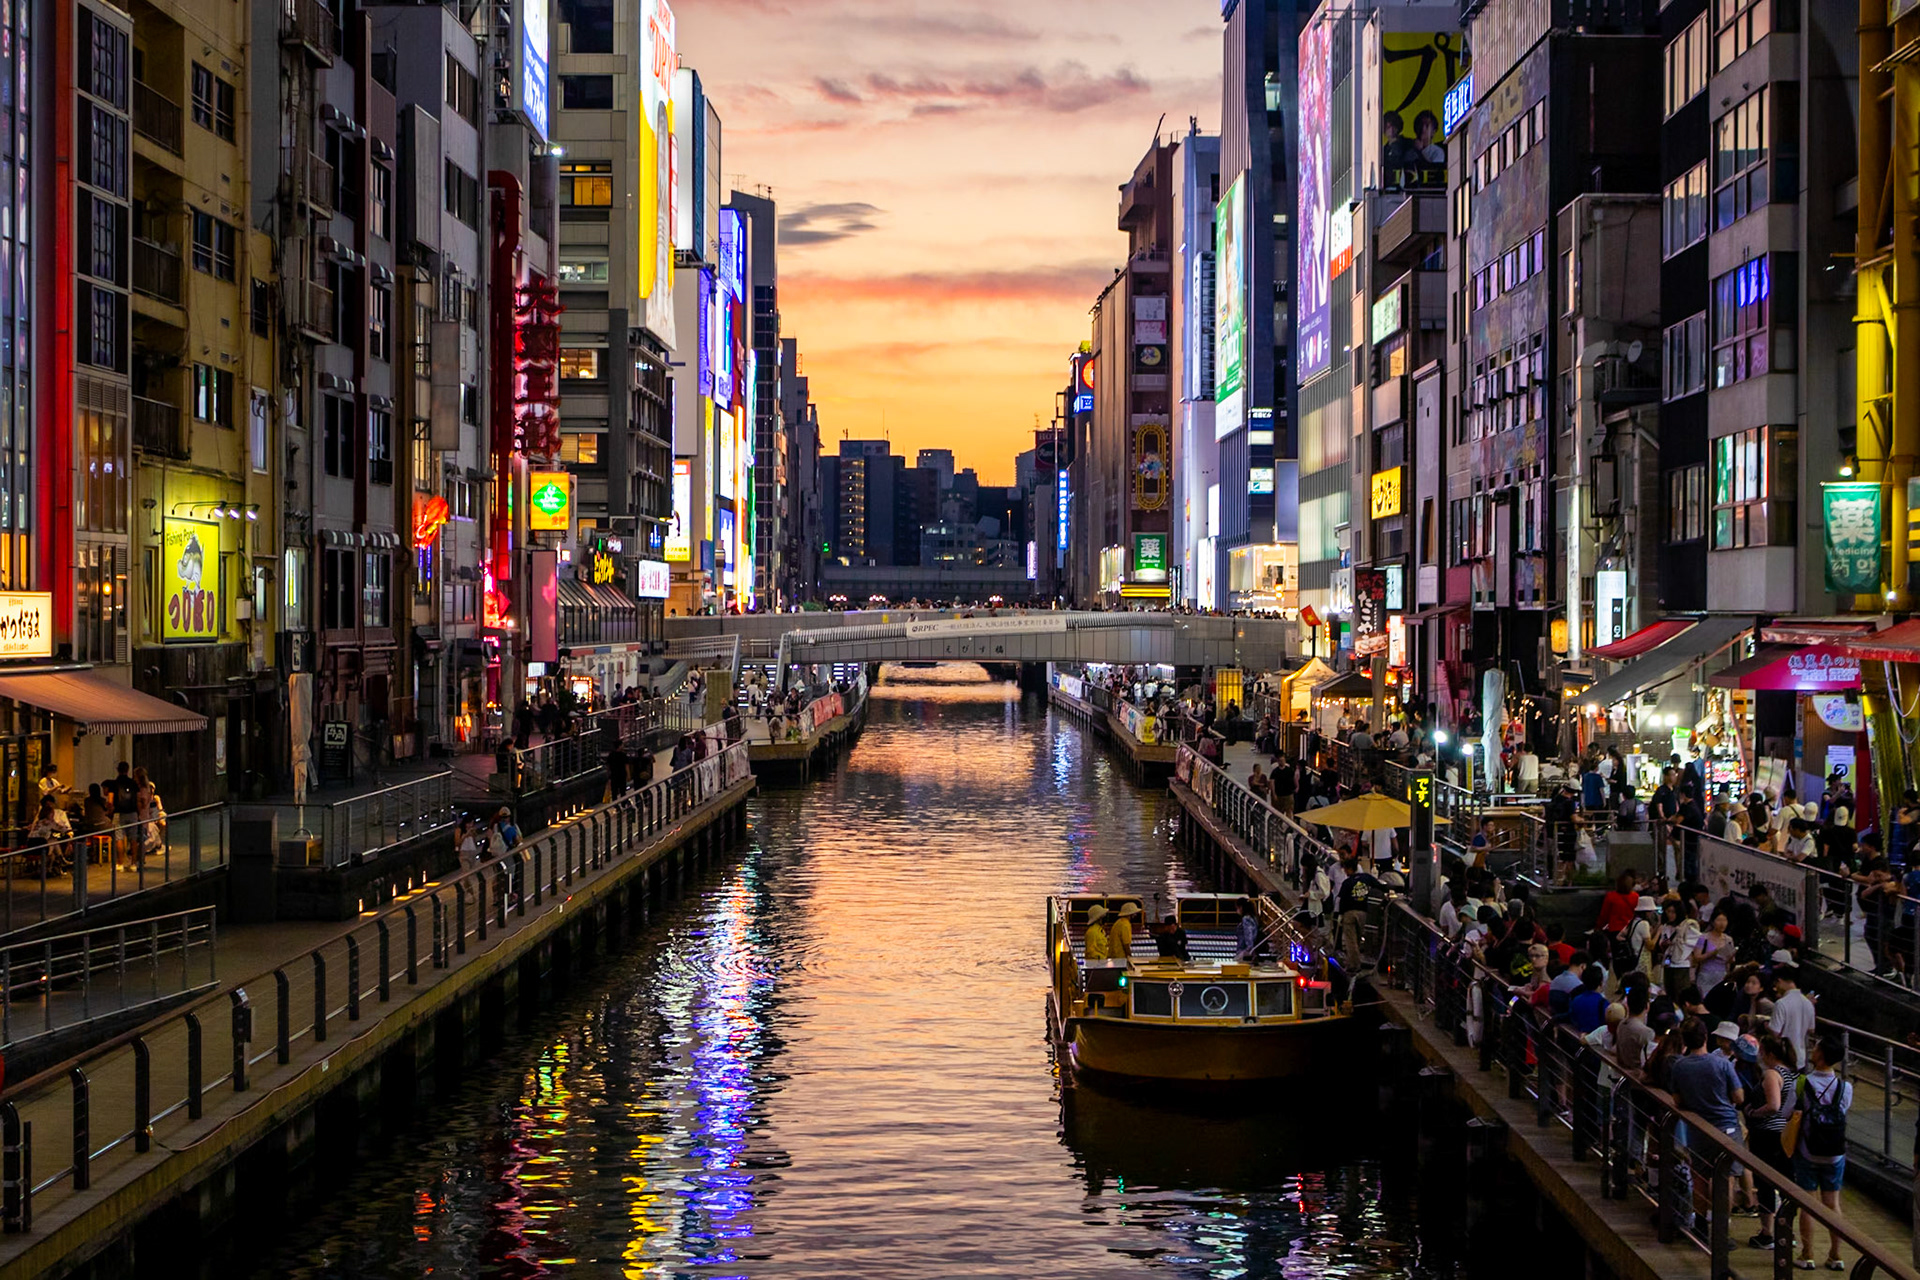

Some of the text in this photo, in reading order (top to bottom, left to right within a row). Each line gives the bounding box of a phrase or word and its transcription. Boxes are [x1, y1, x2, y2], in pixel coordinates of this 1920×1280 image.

[1830, 498, 1876, 545] 薬
[166, 530, 183, 547] Fishing
[1140, 538, 1161, 558] 薬
[1830, 546, 1876, 556] Medicine
